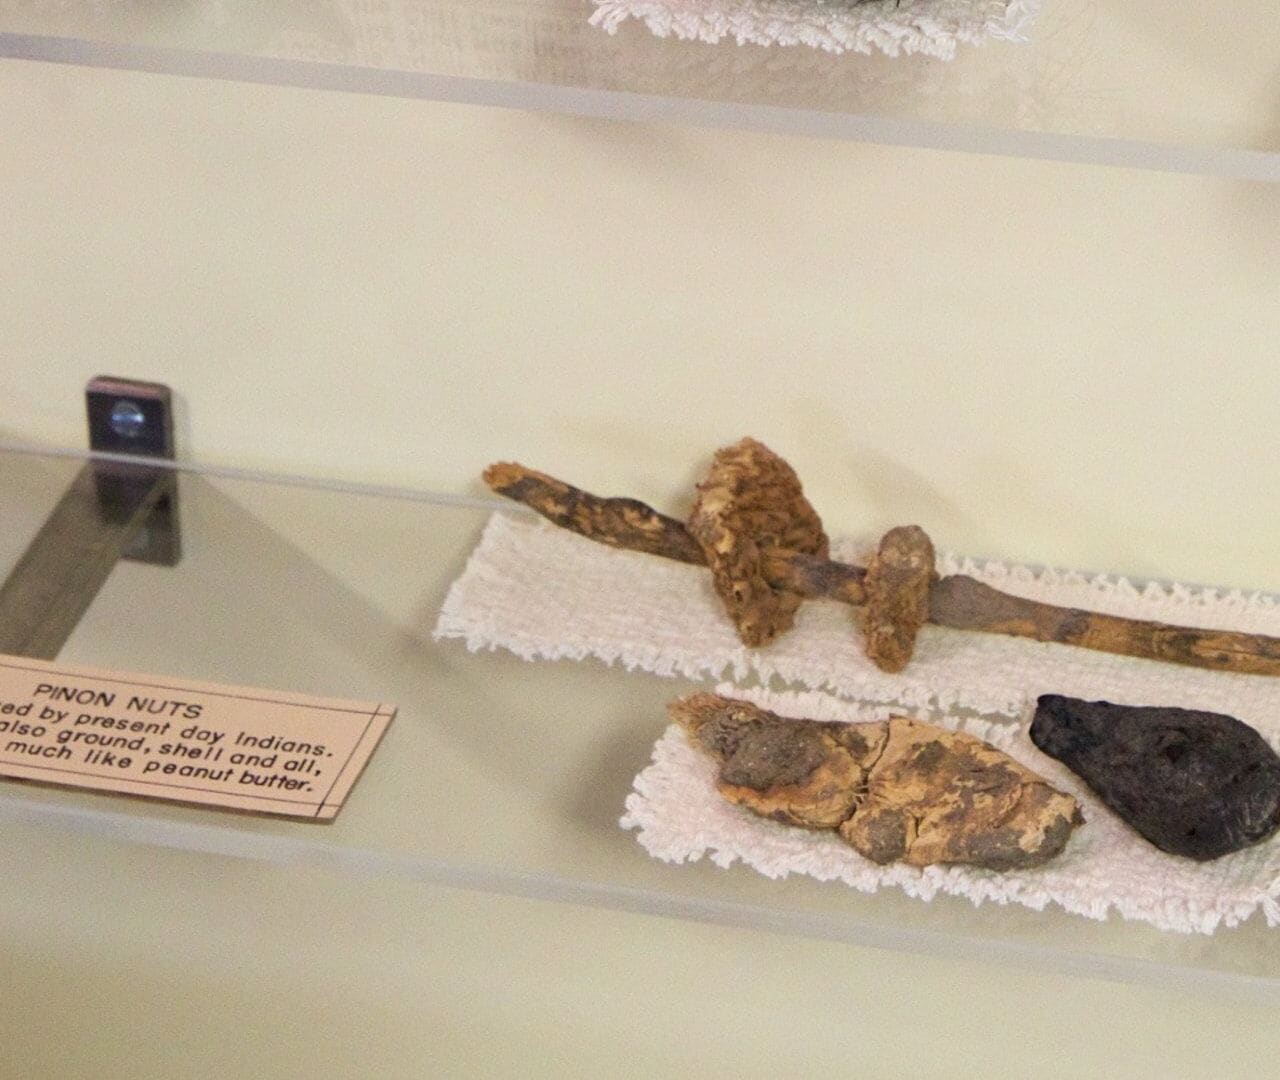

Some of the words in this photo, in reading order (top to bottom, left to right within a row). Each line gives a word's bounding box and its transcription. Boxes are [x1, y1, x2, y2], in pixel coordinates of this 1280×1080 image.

[33, 683, 117, 708] PINON
[126, 696, 204, 720] NUTS
[38, 706, 69, 724] by
[74, 713, 171, 735] present
[179, 725, 226, 746] day
[234, 731, 333, 758] Indians.
[56, 730, 151, 754] ground,
[158, 743, 224, 761] shell
[229, 753, 278, 769] and
[283, 758, 322, 777] all,
